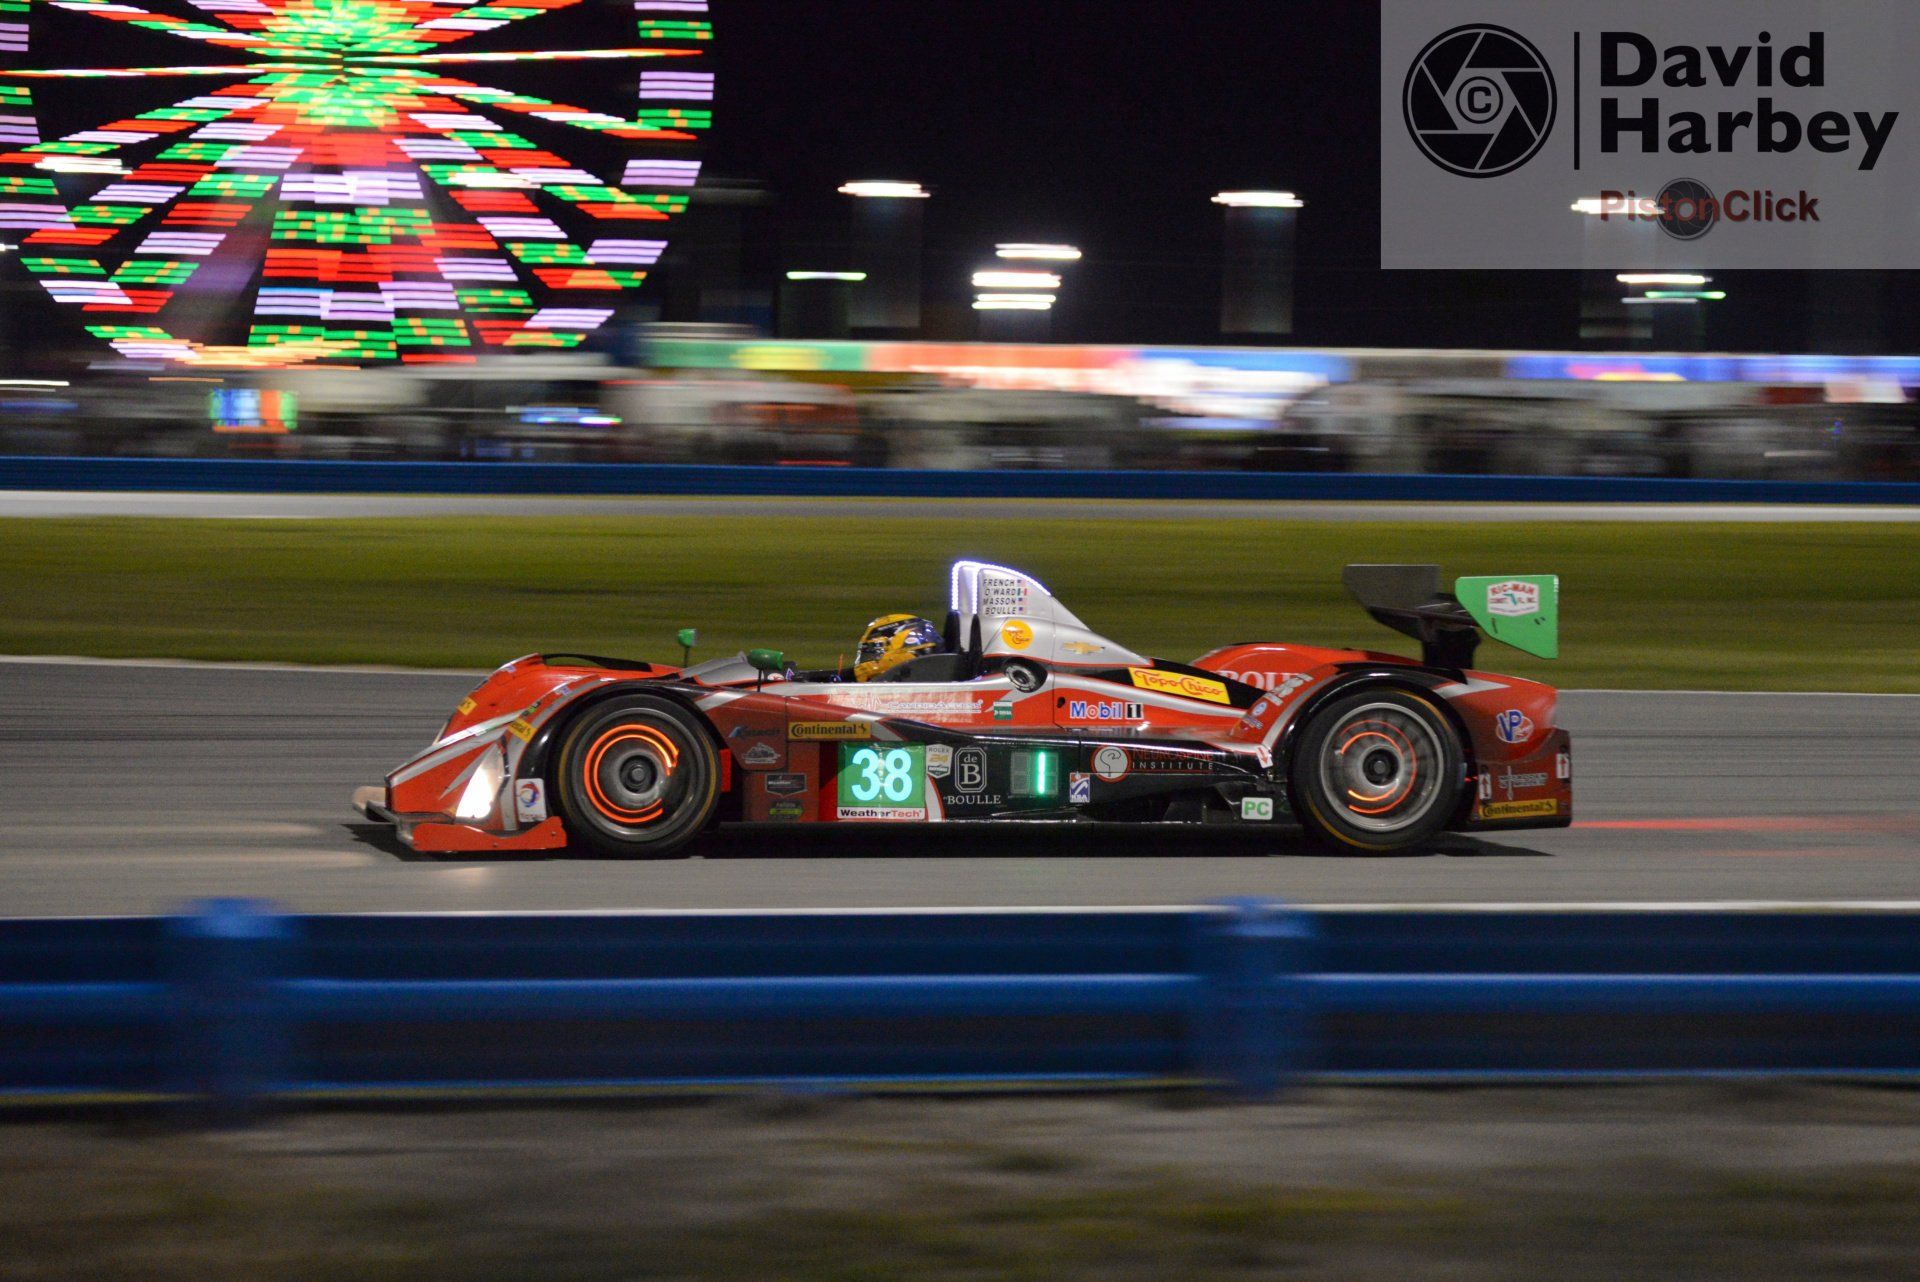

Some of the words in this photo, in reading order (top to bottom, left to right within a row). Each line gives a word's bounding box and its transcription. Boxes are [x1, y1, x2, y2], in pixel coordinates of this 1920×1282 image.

[985, 588, 1016, 596] O'WARD
[983, 597, 1016, 605] MASSON
[985, 607, 1017, 615] BOULLE
[1134, 670, 1178, 687] Topo
[1180, 677, 1223, 695] Chico
[1070, 702, 1122, 719] Mobil
[791, 723, 857, 738] Continental
[1497, 710, 1523, 741] VP
[963, 754, 978, 763] de
[1132, 761, 1214, 770] INSTITUTE
[852, 748, 913, 802] 38
[960, 763, 982, 785] B
[947, 794, 1002, 804] BOULLE
[1244, 802, 1270, 816] PC
